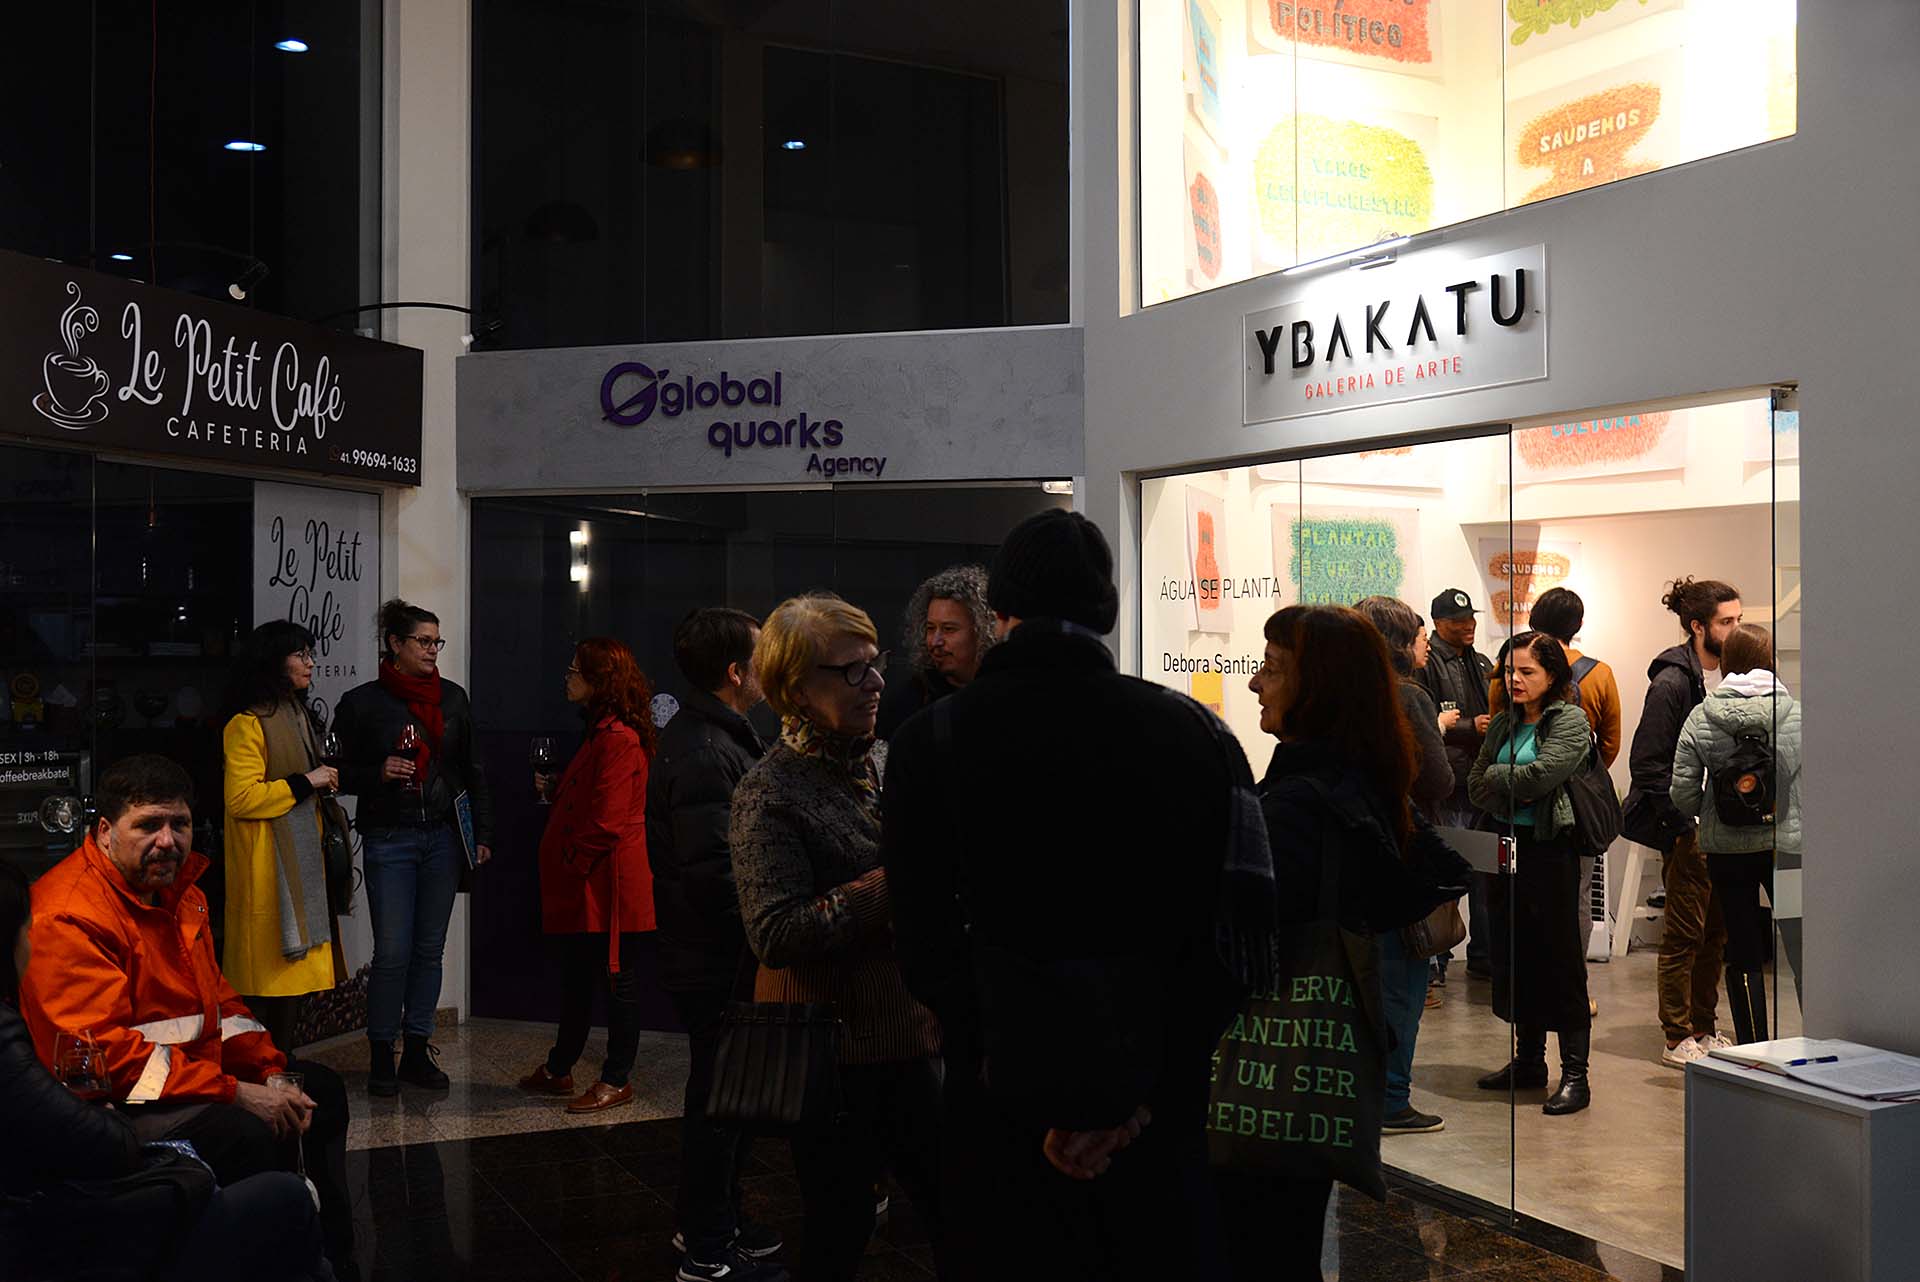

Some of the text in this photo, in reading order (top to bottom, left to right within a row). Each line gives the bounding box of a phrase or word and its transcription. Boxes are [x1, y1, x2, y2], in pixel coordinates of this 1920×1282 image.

[1539, 108, 1641, 153] SAUDEMOS
[1583, 158, 1594, 175] A
[1255, 268, 1526, 375] YBAKATU
[118, 302, 345, 439] Le Petit Café
[1305, 356, 1463, 399] GALERIA DE ARTE
[660, 368, 782, 417] global
[167, 416, 308, 455] CAFETERIA
[708, 412, 844, 457] quarks
[352, 449, 416, 473] 99694-1633
[806, 453, 887, 478] Agency
[269, 515, 363, 593] Le Petit
[1160, 576, 1281, 600] ÁGUA SE PLANTA
[1163, 652, 1210, 673] Debora
[1222, 1013, 1359, 1053] ANINHA
[1237, 1058, 1277, 1090] UM
[1292, 1065, 1357, 1098] SER
[1206, 1101, 1355, 1148] EBELDE
